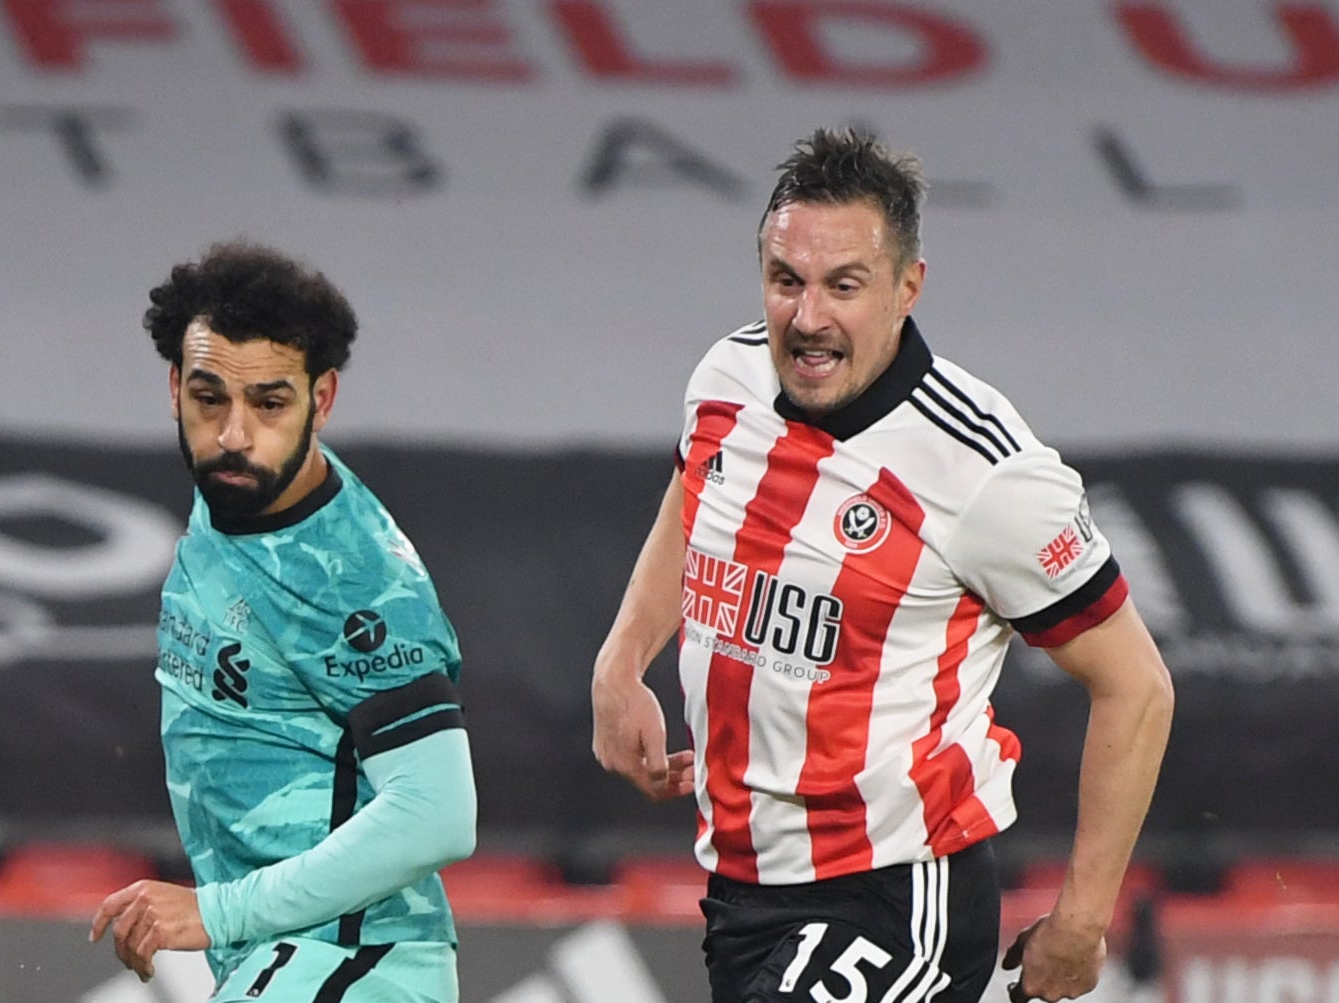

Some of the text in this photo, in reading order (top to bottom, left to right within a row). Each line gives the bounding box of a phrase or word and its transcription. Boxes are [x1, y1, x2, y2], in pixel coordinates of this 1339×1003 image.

[744, 570, 844, 665] USG
[323, 643, 425, 684] Expedia
[772, 660, 831, 684] GROUP
